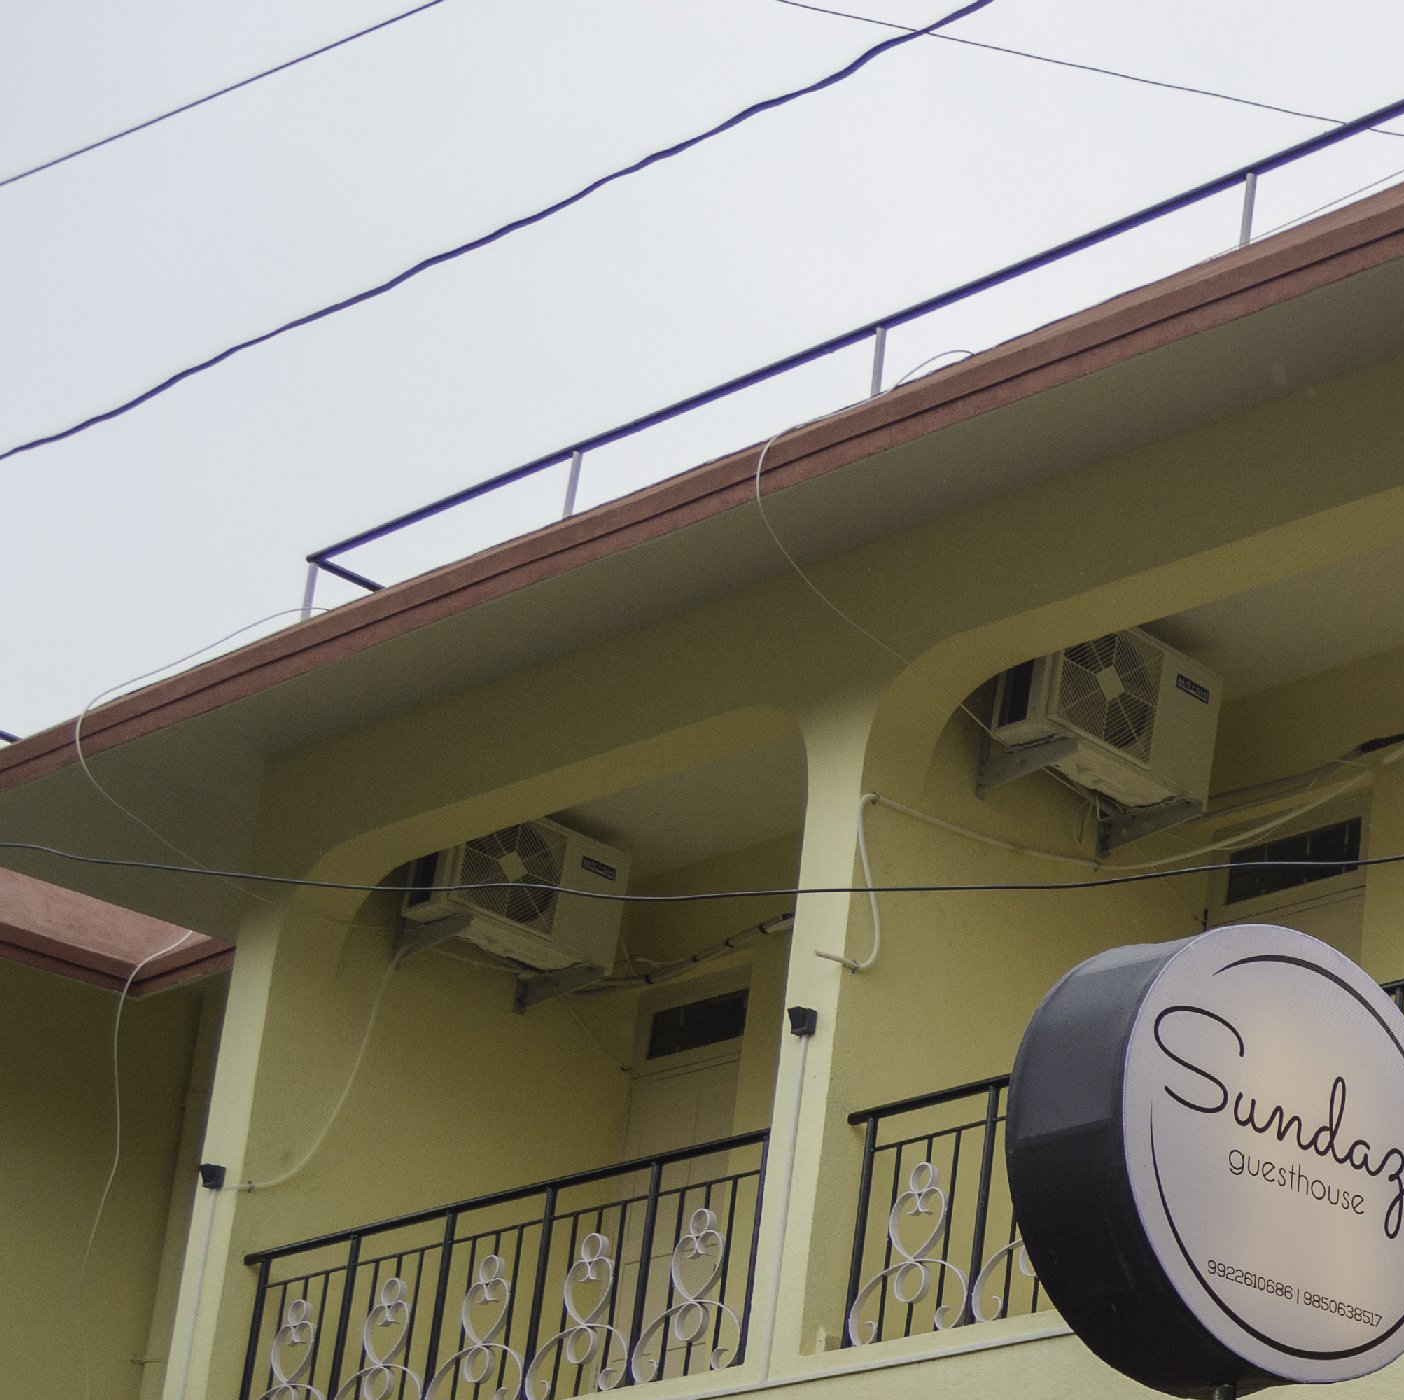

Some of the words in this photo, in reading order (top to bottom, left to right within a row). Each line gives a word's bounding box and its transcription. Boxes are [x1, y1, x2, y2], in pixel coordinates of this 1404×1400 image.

[1228, 1149, 1364, 1215] guesthouse
[1207, 1260, 1294, 1300] 9922610686
[1303, 1291, 1383, 1328] 9850638517
